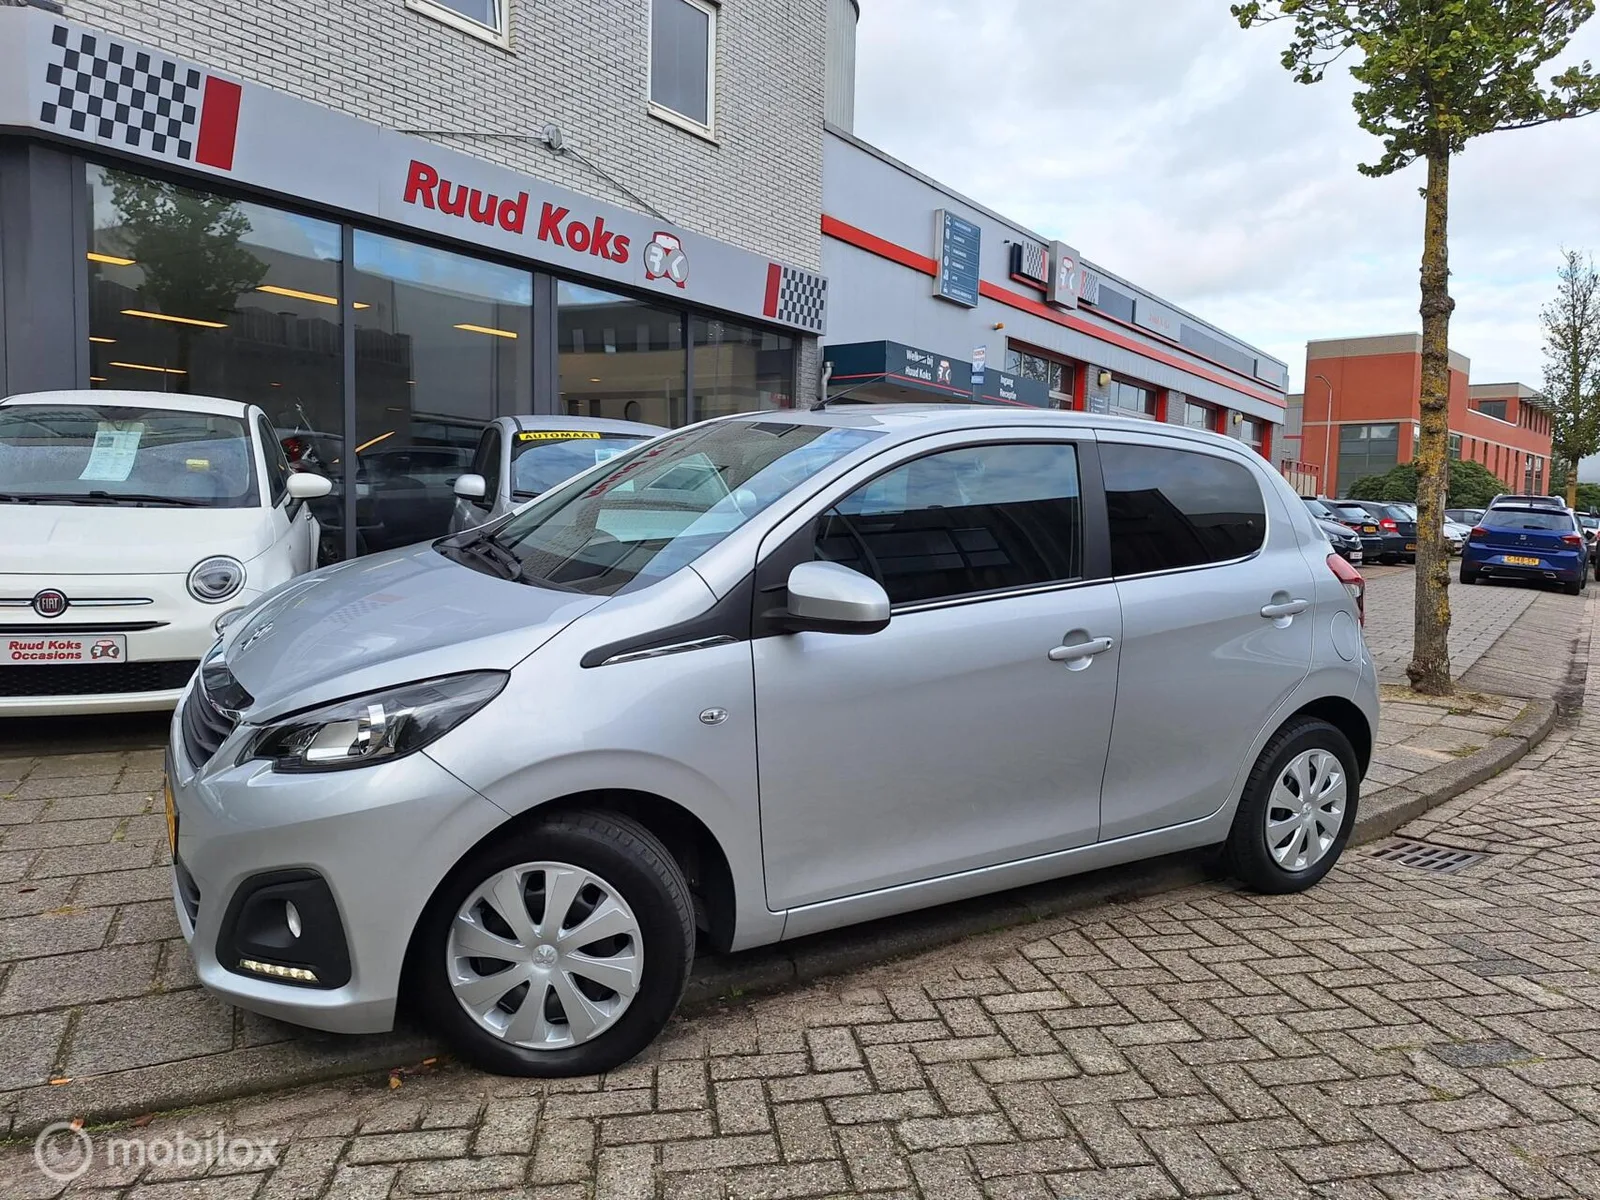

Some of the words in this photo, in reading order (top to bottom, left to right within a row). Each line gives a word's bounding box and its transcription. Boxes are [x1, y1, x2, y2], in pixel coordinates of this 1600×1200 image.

[403, 159, 530, 235] Ruud
[537, 201, 632, 264] Koks
[904, 365, 919, 378] Ruud
[919, 368, 932, 381] Koks
[524, 432, 597, 440] AUTOMAAT
[41, 597, 59, 610] FIAT
[9, 641, 45, 650] Ruud
[48, 640, 82, 650] Koks
[11, 650, 82, 660] Occasions
